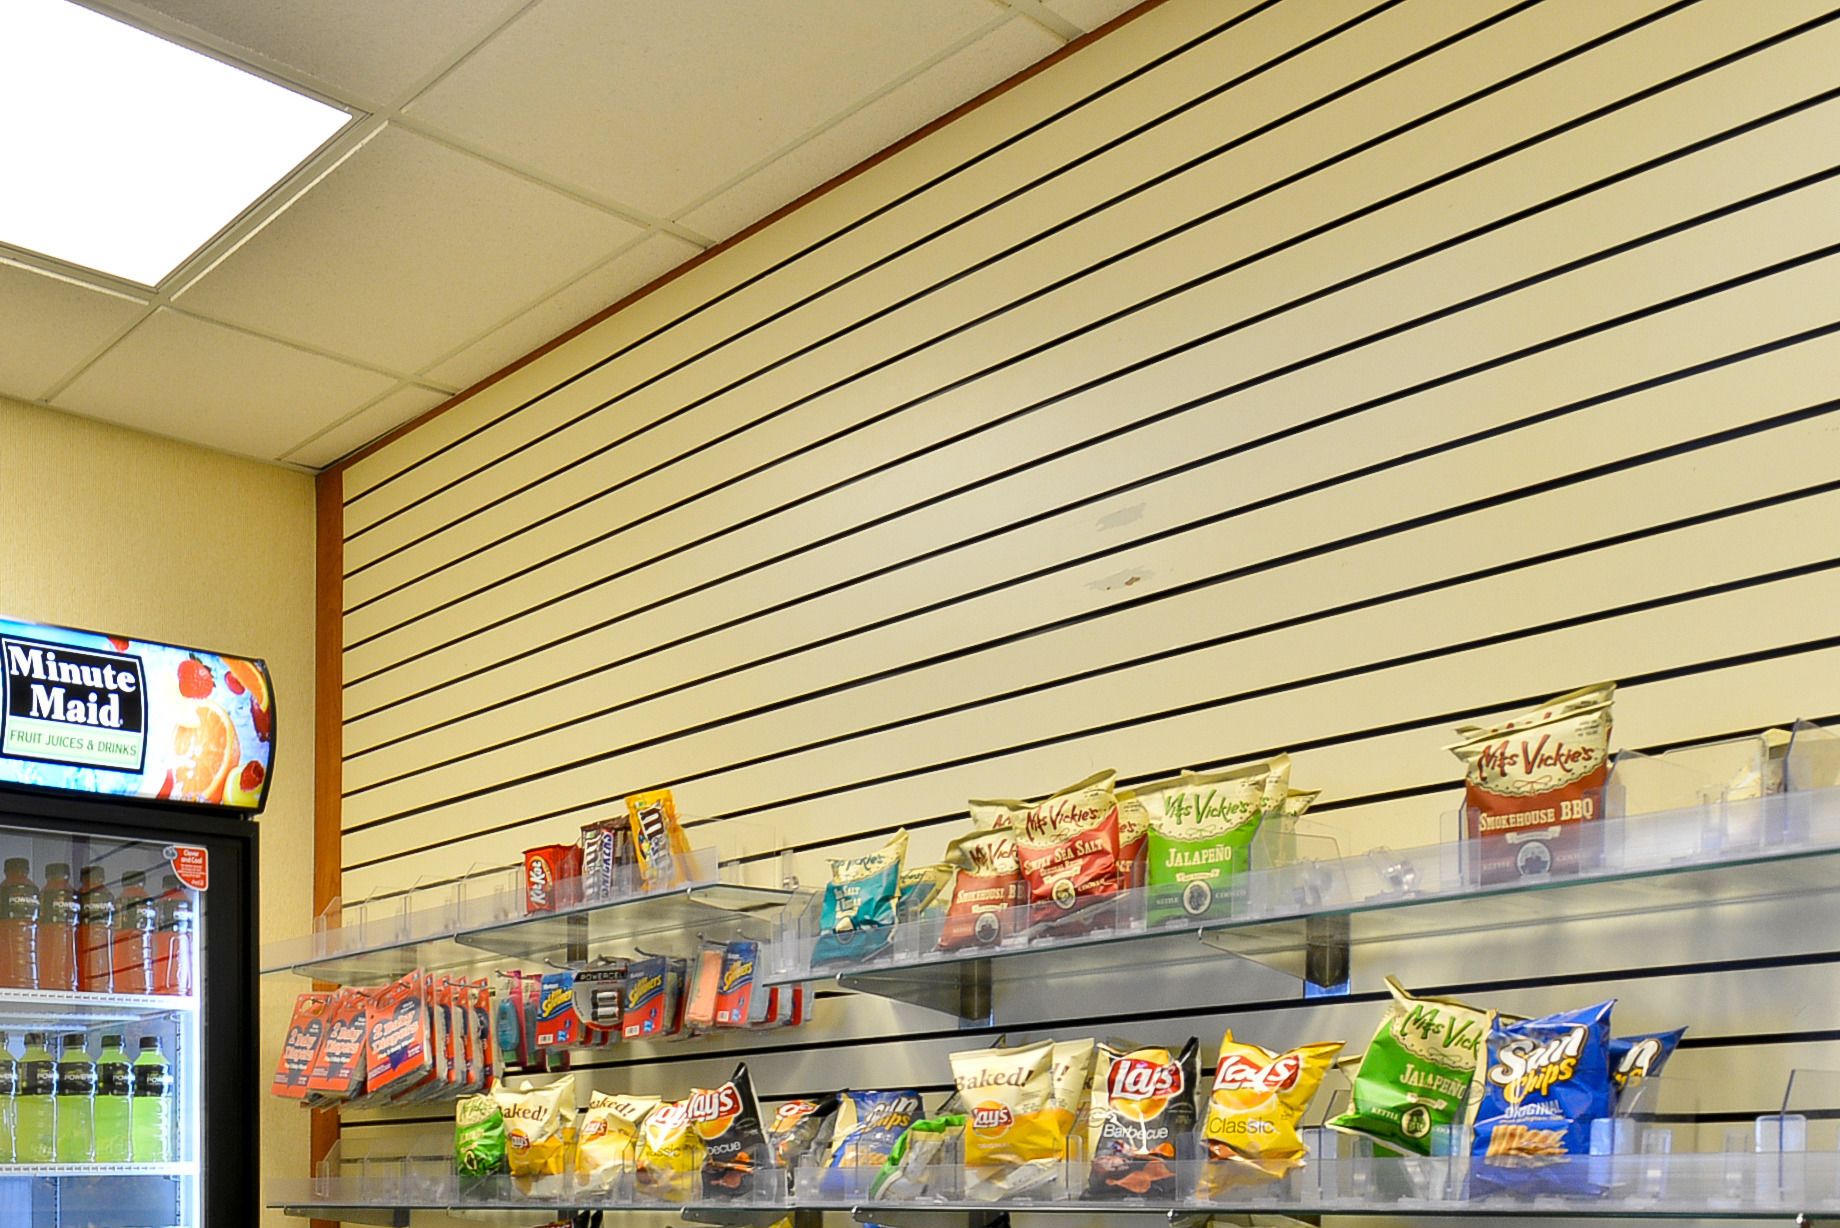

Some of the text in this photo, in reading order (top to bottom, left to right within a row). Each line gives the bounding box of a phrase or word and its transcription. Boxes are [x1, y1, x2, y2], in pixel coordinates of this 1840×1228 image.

[8, 644, 137, 693] Minute
[29, 683, 121, 728] Maid
[9, 729, 138, 758] FRUIT JUICES & DRINKS
[1522, 734, 1595, 774] Vickie's
[1048, 800, 1100, 832] Vickie's
[1194, 789, 1250, 825] Vickie's
[1479, 797, 1594, 832] SMOKEHOUSE BBQ
[1075, 837, 1105, 856] SALT
[1165, 844, 1232, 868] JALAPEÑO
[1488, 1025, 1590, 1086] Sun
[1104, 1124, 1168, 1141] Barbecue
[1209, 1117, 1276, 1136] Classic
